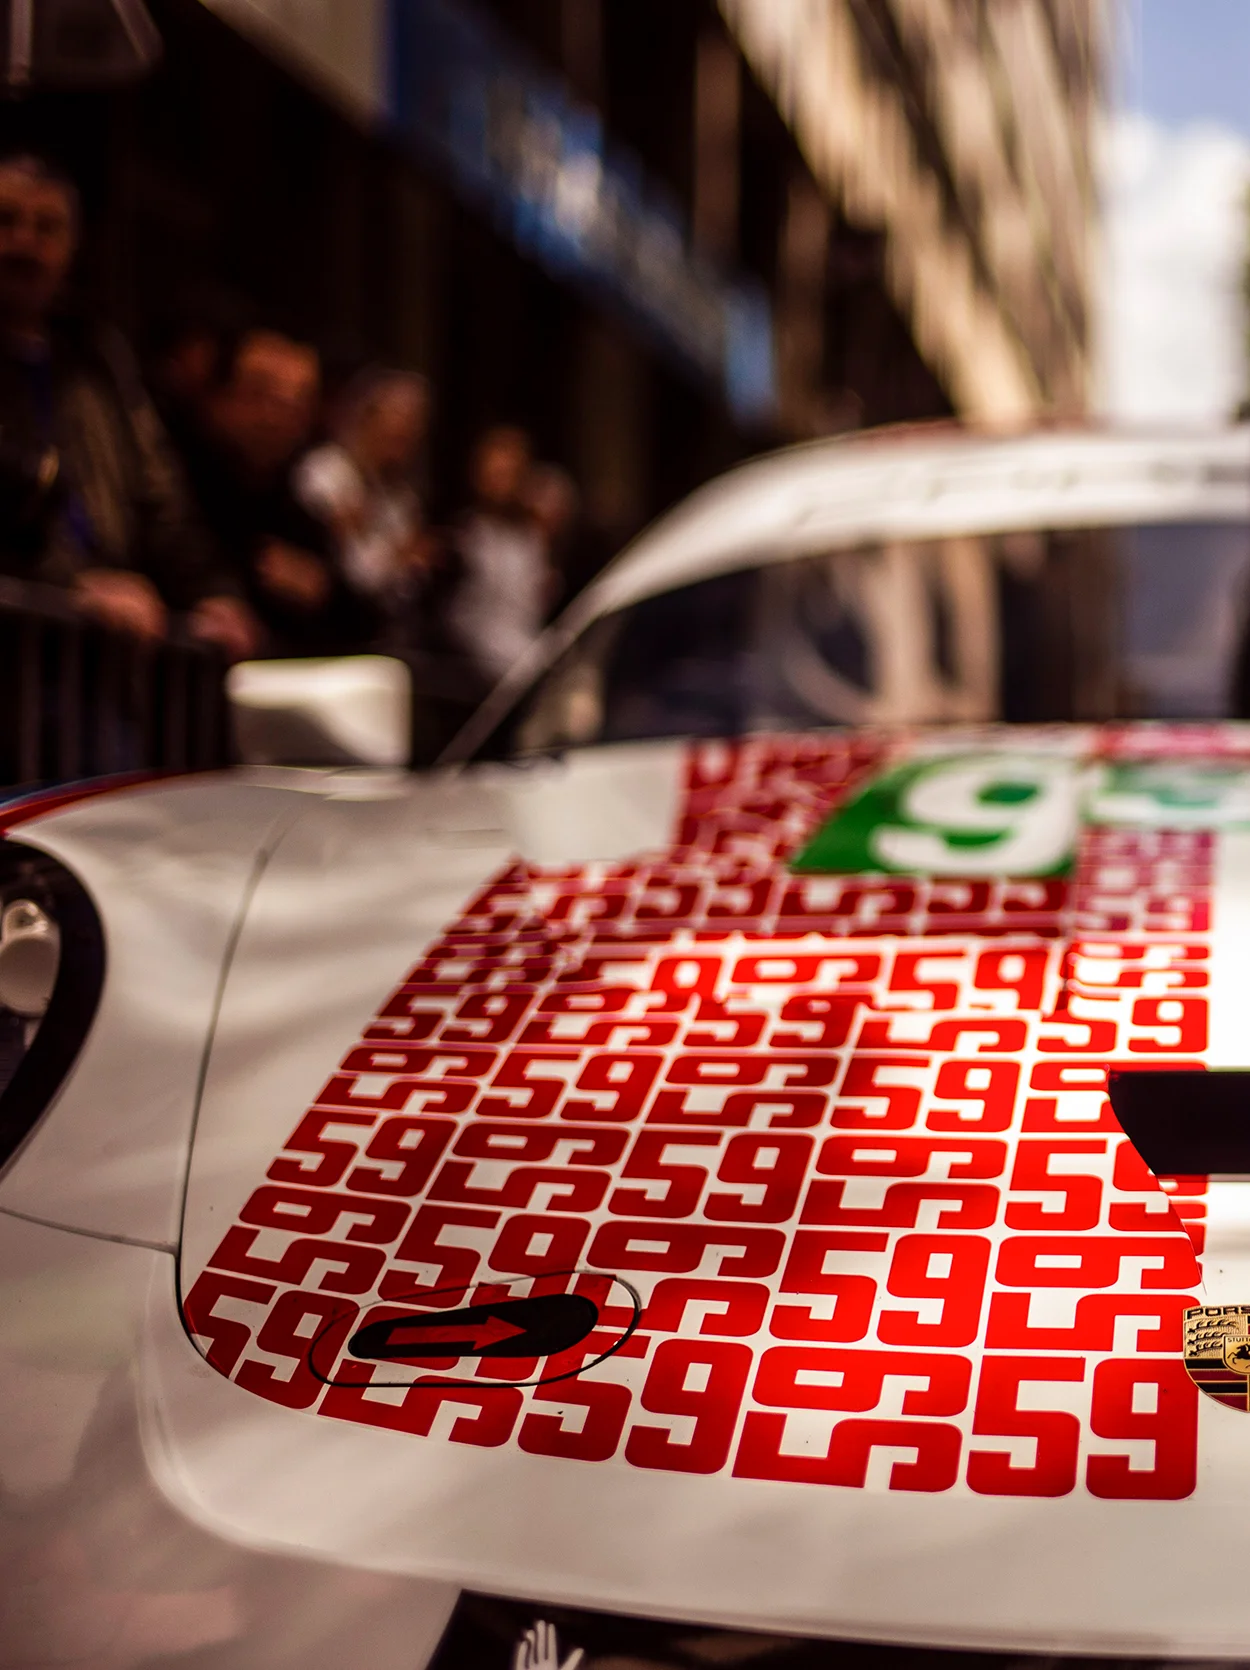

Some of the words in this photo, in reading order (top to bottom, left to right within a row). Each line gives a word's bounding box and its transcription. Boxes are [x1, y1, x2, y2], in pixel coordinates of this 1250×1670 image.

[360, 990, 540, 1043] 59
[311, 1044, 500, 1115] 59
[475, 1047, 663, 1122] 59
[645, 1053, 840, 1129] 59
[829, 1053, 1020, 1133] 59
[265, 1106, 459, 1198] 59
[424, 1121, 631, 1213] 59
[607, 1128, 815, 1224] 59
[797, 1135, 1008, 1230] 59
[206, 1185, 413, 1296] 59
[377, 1203, 592, 1309] 59
[566, 1220, 787, 1338] 59
[768, 1229, 992, 1348] 59
[183, 1271, 361, 1410] 59
[984, 1235, 1201, 1353] 59
[515, 1330, 754, 1475] 59
[731, 1345, 973, 1493] 59
[965, 1355, 1200, 1501] 59
